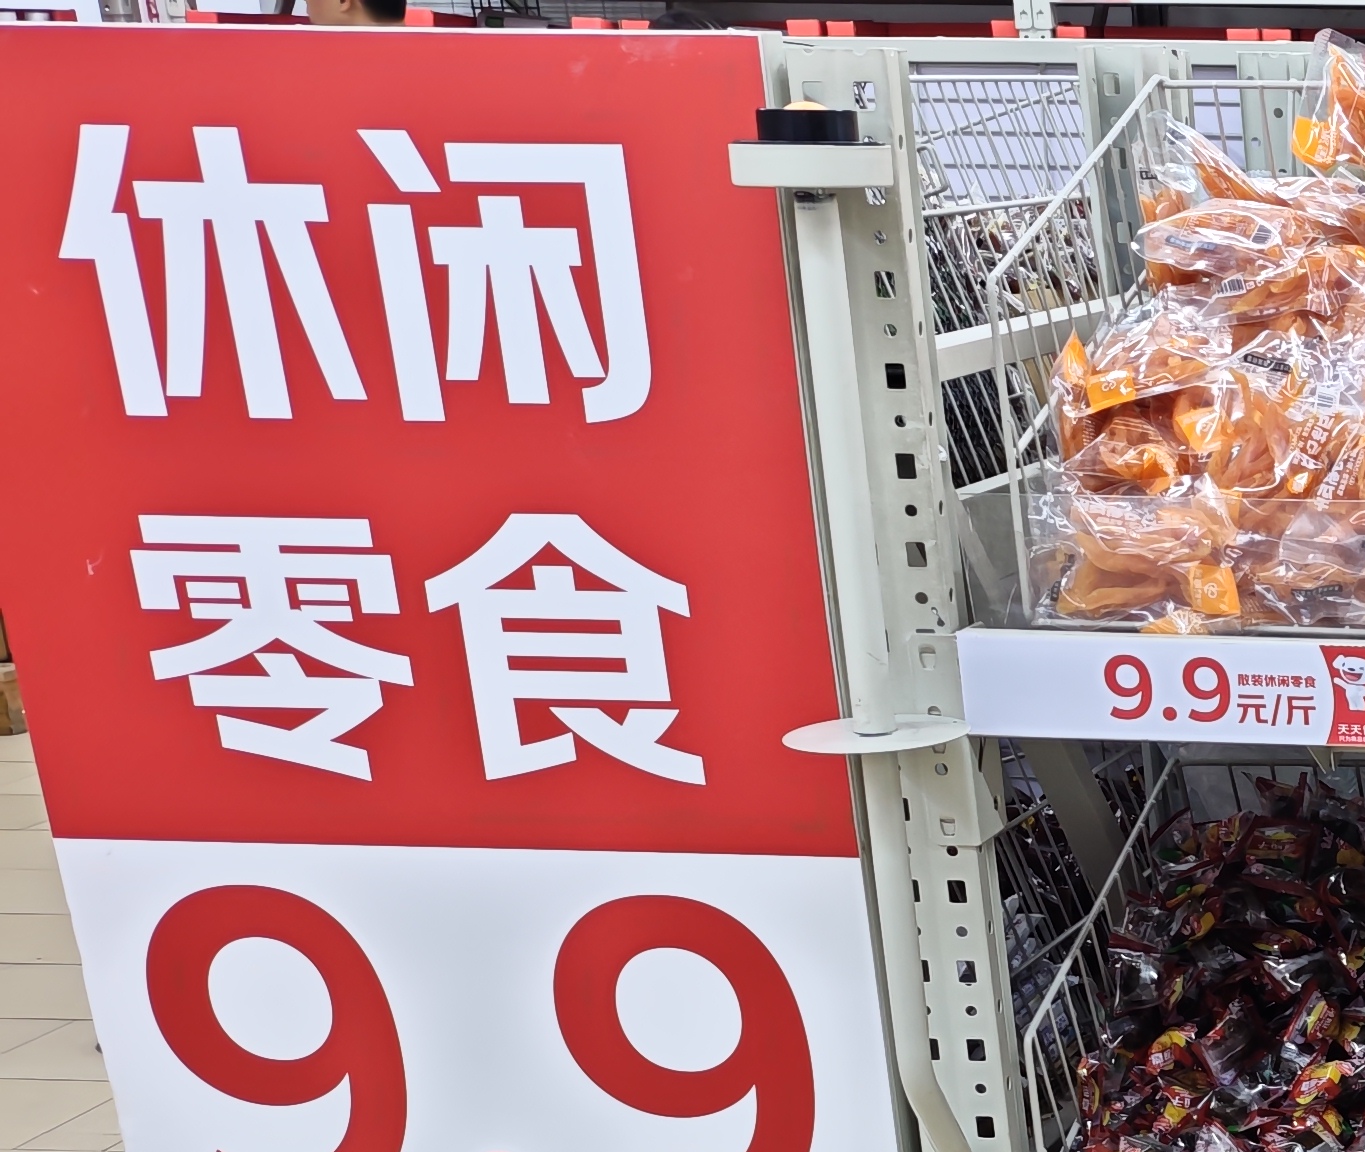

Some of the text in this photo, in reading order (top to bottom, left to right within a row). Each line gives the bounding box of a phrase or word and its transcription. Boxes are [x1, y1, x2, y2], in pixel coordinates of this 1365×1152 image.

[59, 124, 653, 422] 休闲
[130, 513, 707, 786] 零食
[1237, 673, 1317, 689] 散装休闲零食
[1104, 655, 1230, 722] 9.9
[1237, 694, 1316, 726] 元/斤
